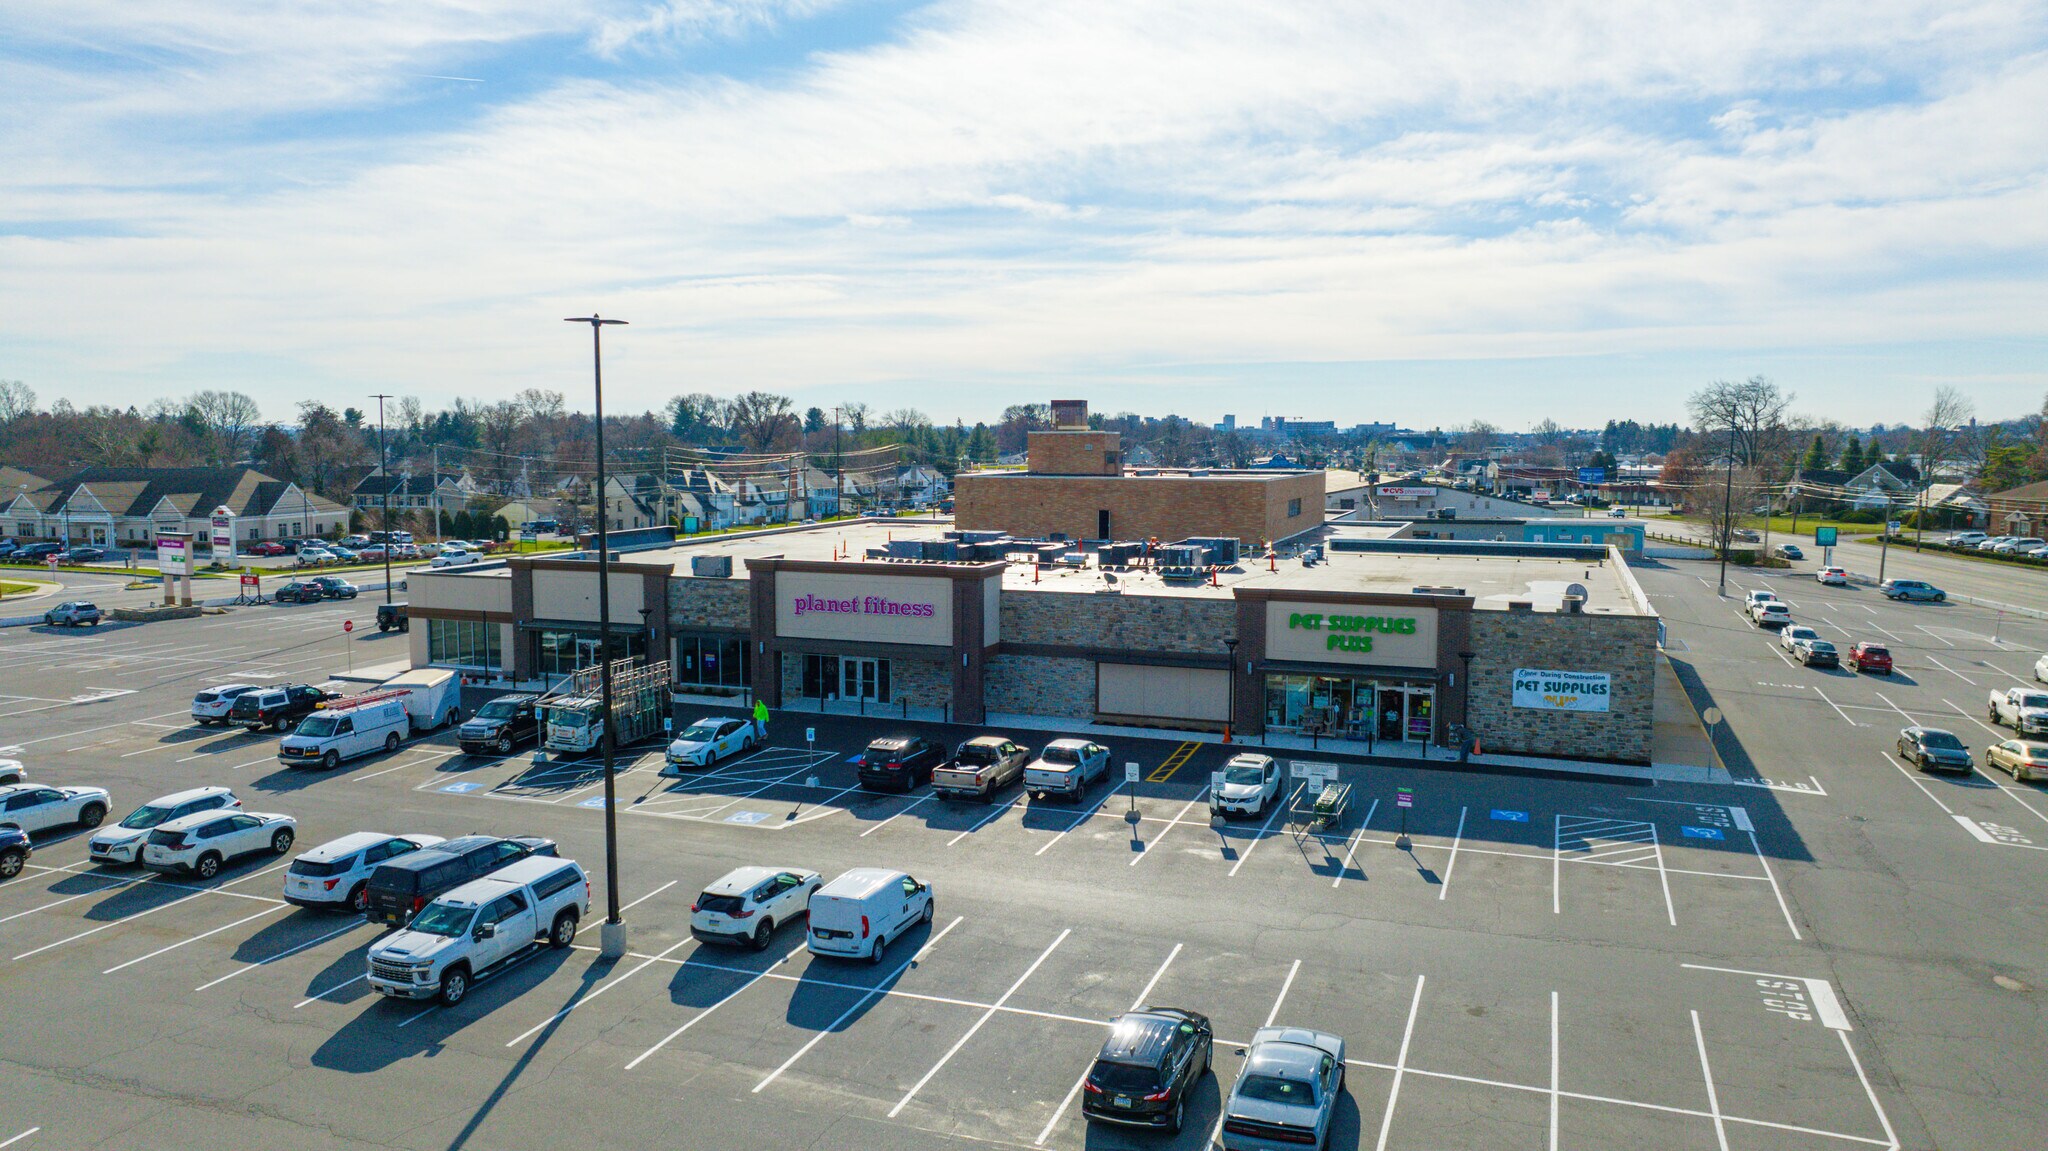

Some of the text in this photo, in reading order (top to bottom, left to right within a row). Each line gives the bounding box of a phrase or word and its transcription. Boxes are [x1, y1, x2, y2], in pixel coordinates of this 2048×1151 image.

[794, 594, 934, 617] planet fitness
[1289, 613, 1417, 635] PET SUPPLIES
[1327, 634, 1373, 653] PLUS
[1540, 671, 1562, 679] During
[1563, 672, 1606, 681] Construction
[1515, 680, 1608, 695] PET SUPPLIES
[1543, 695, 1578, 708] PLUS
[1756, 979, 1813, 1021] STOP
